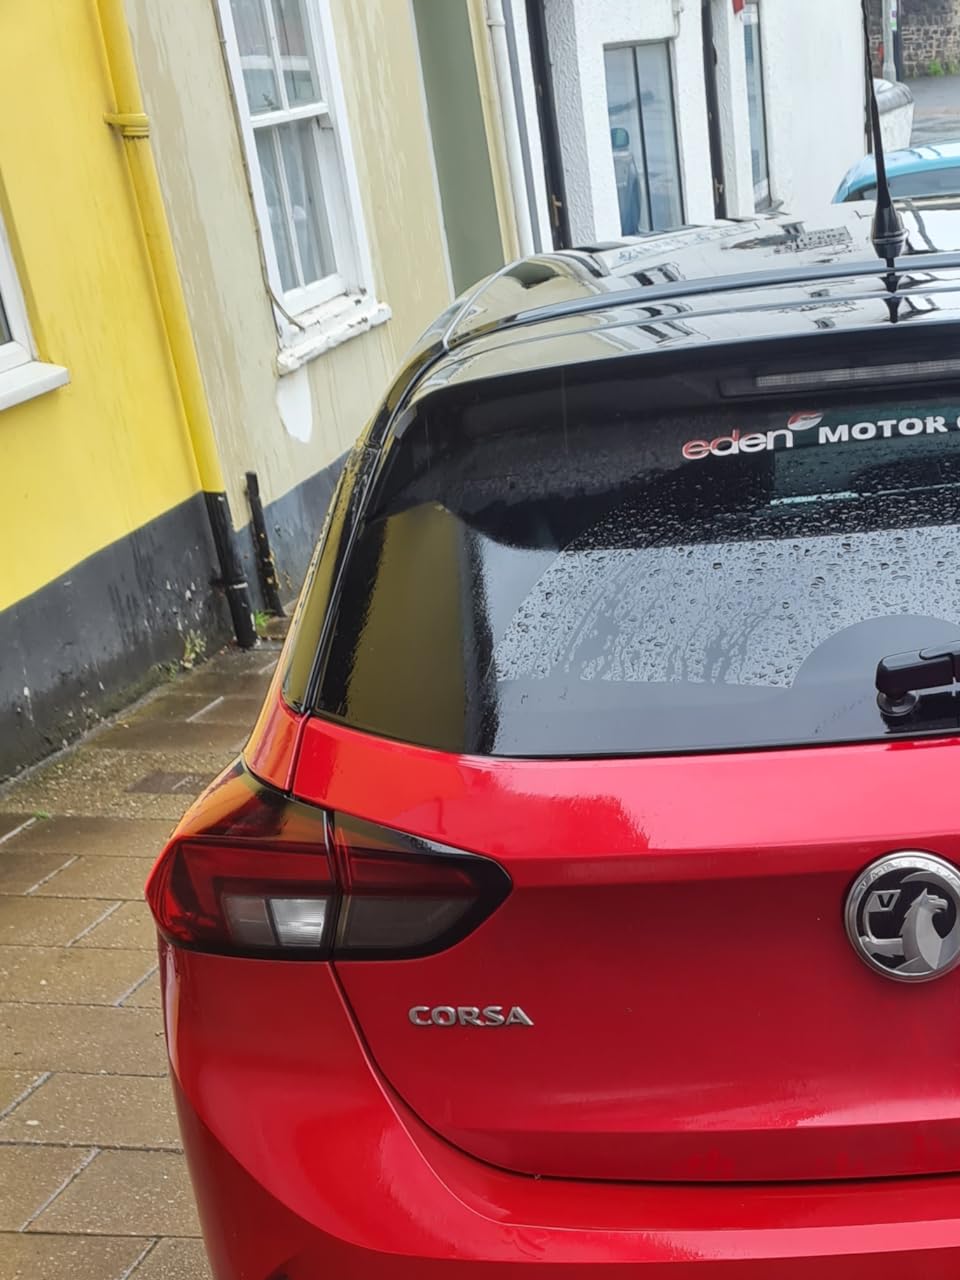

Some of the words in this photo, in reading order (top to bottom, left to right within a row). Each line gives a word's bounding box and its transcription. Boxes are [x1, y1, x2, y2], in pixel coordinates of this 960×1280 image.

[681, 427, 794, 460] eden
[818, 414, 949, 444] MOTOR
[408, 1005, 535, 1026] CORSA
